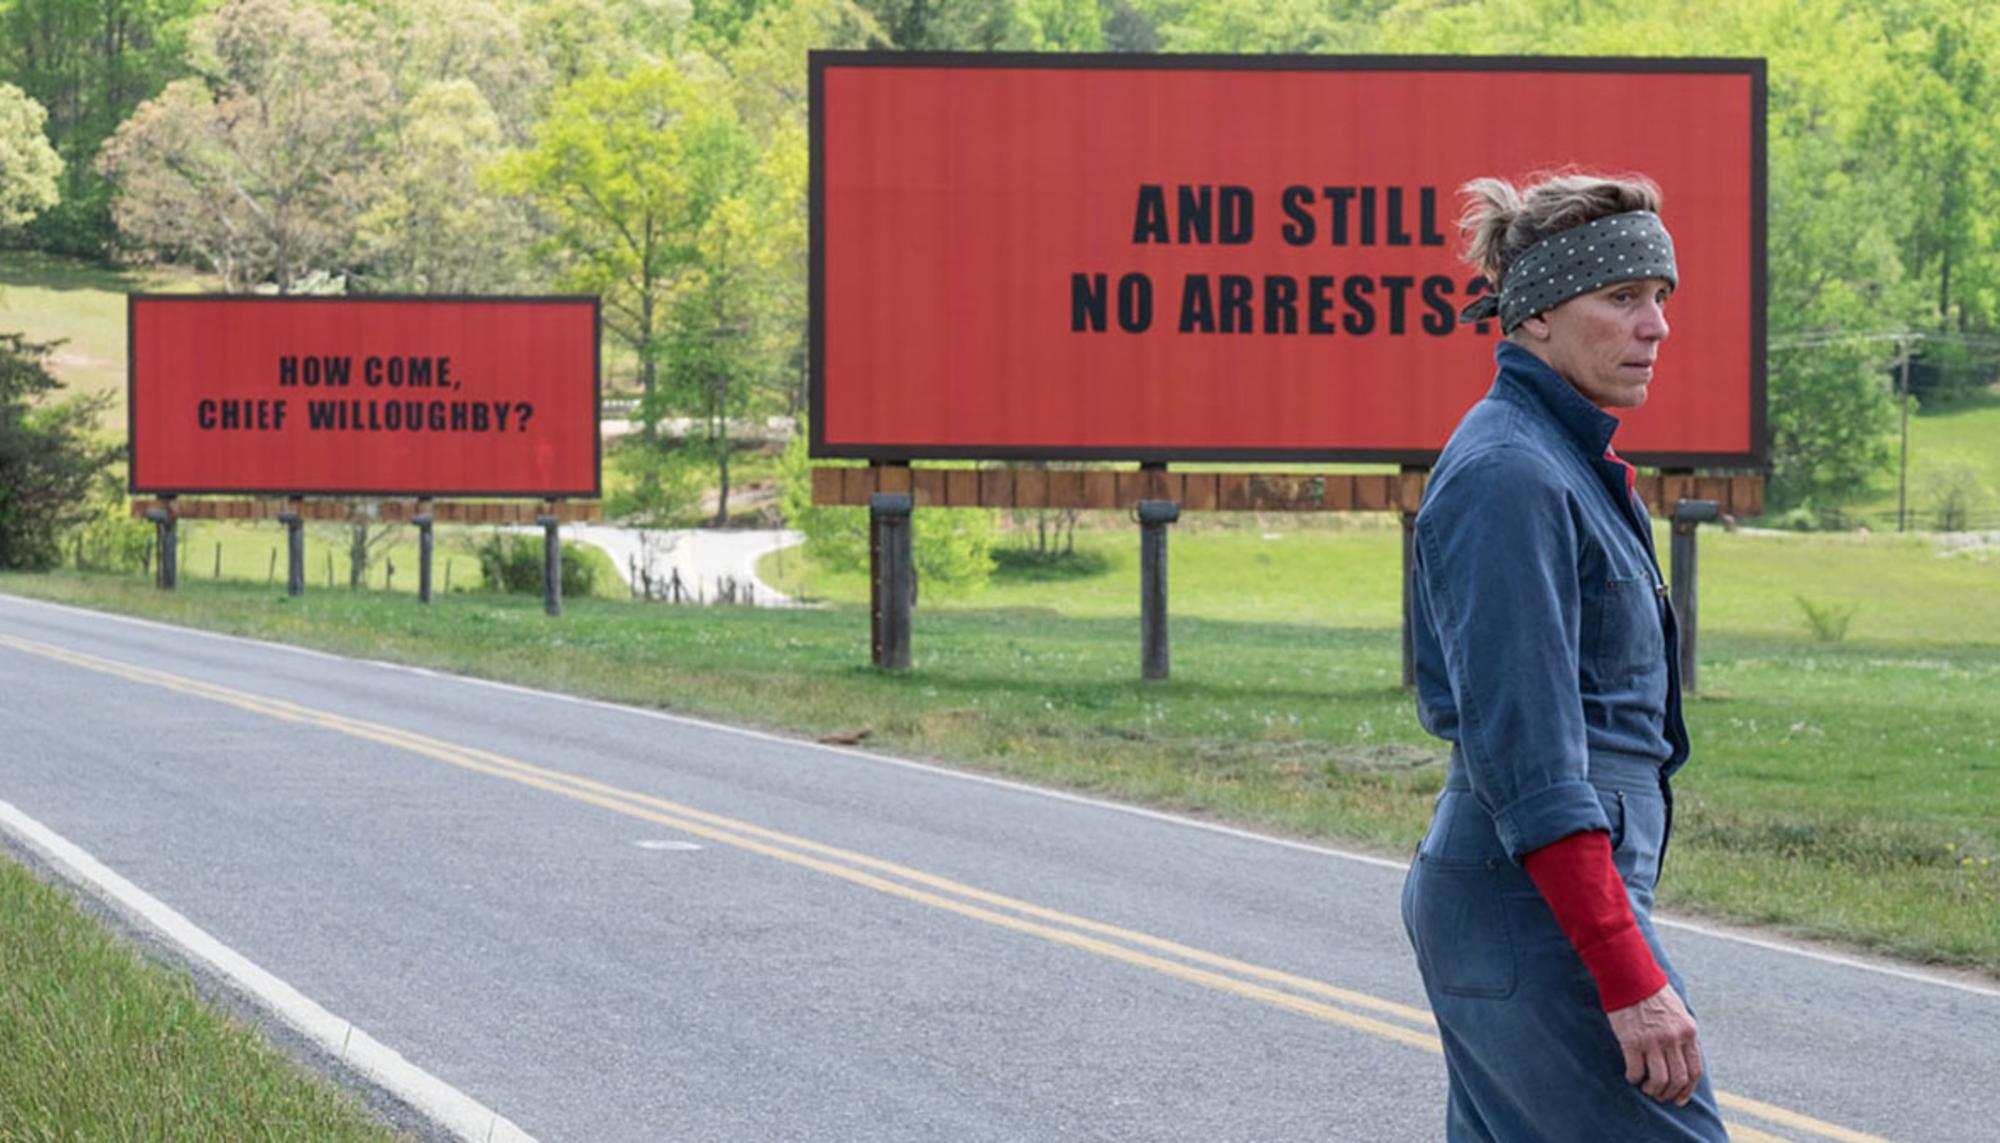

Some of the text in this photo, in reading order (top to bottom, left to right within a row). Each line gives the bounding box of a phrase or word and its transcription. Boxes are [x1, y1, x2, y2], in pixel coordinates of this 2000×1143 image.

[1131, 184, 1446, 247] AND STILL
[1070, 272, 1155, 335] NO
[279, 356, 462, 390] HOW COME,
[198, 399, 535, 433] CHIEF WILLOUGHBY?
